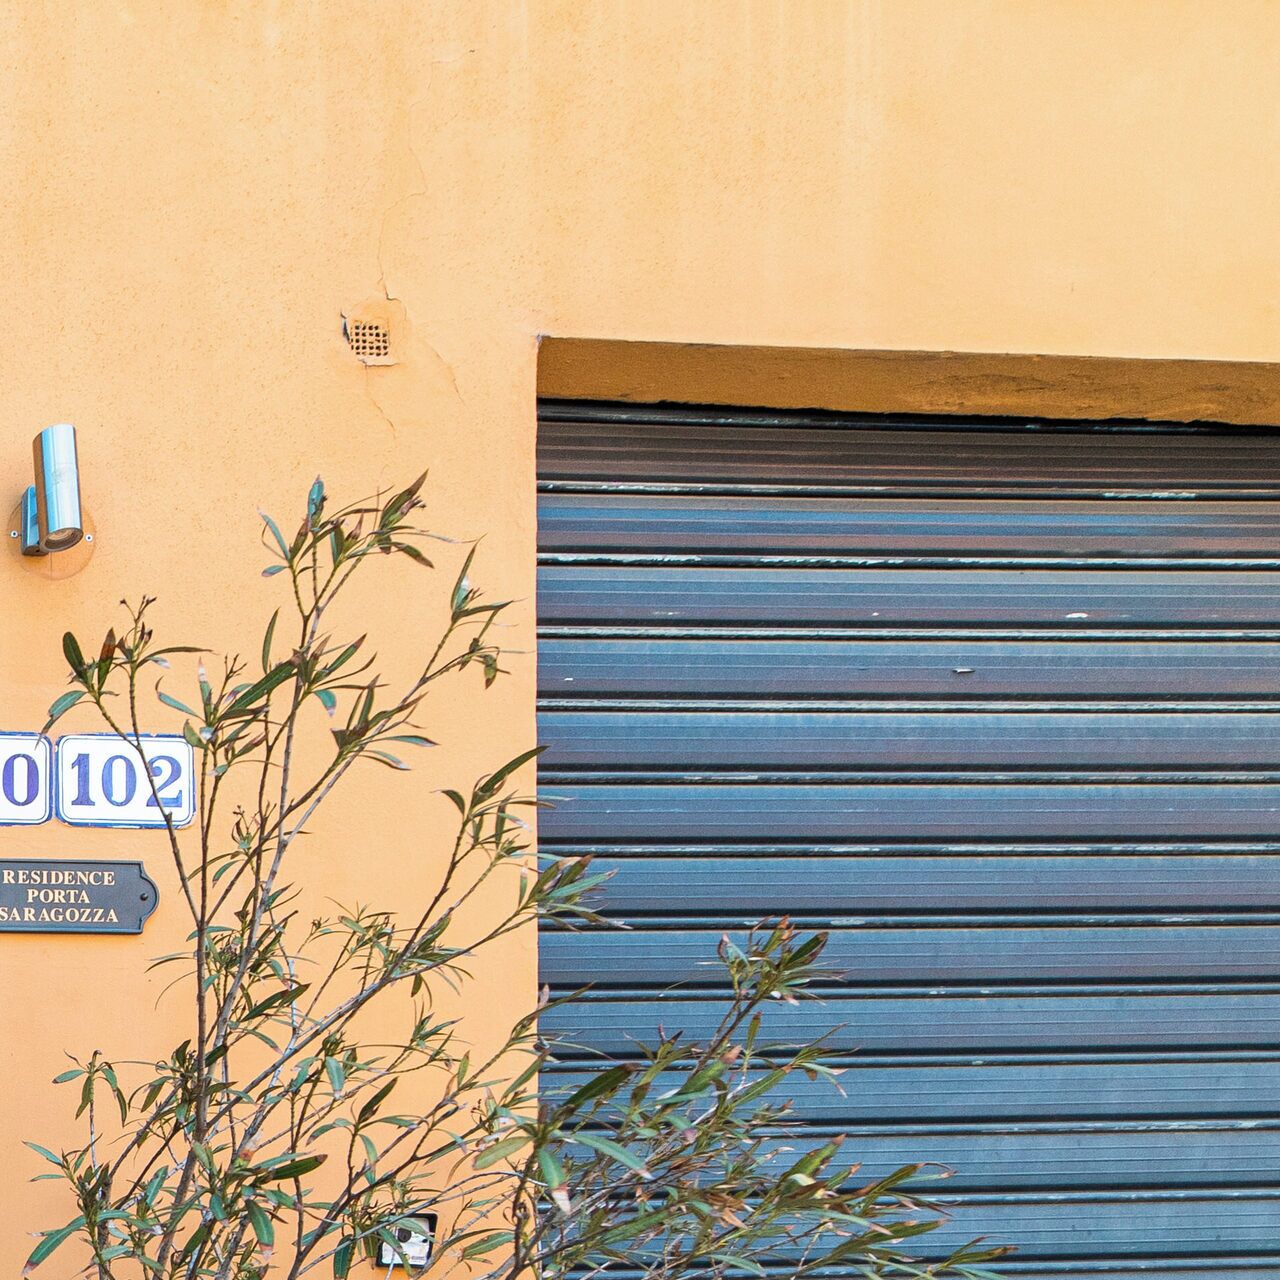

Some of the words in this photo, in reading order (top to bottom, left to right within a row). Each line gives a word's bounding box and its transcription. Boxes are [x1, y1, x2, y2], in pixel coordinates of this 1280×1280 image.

[71, 753, 183, 807] 102
[2, 869, 116, 886] RESIDENCE
[26, 888, 91, 904] PORTA
